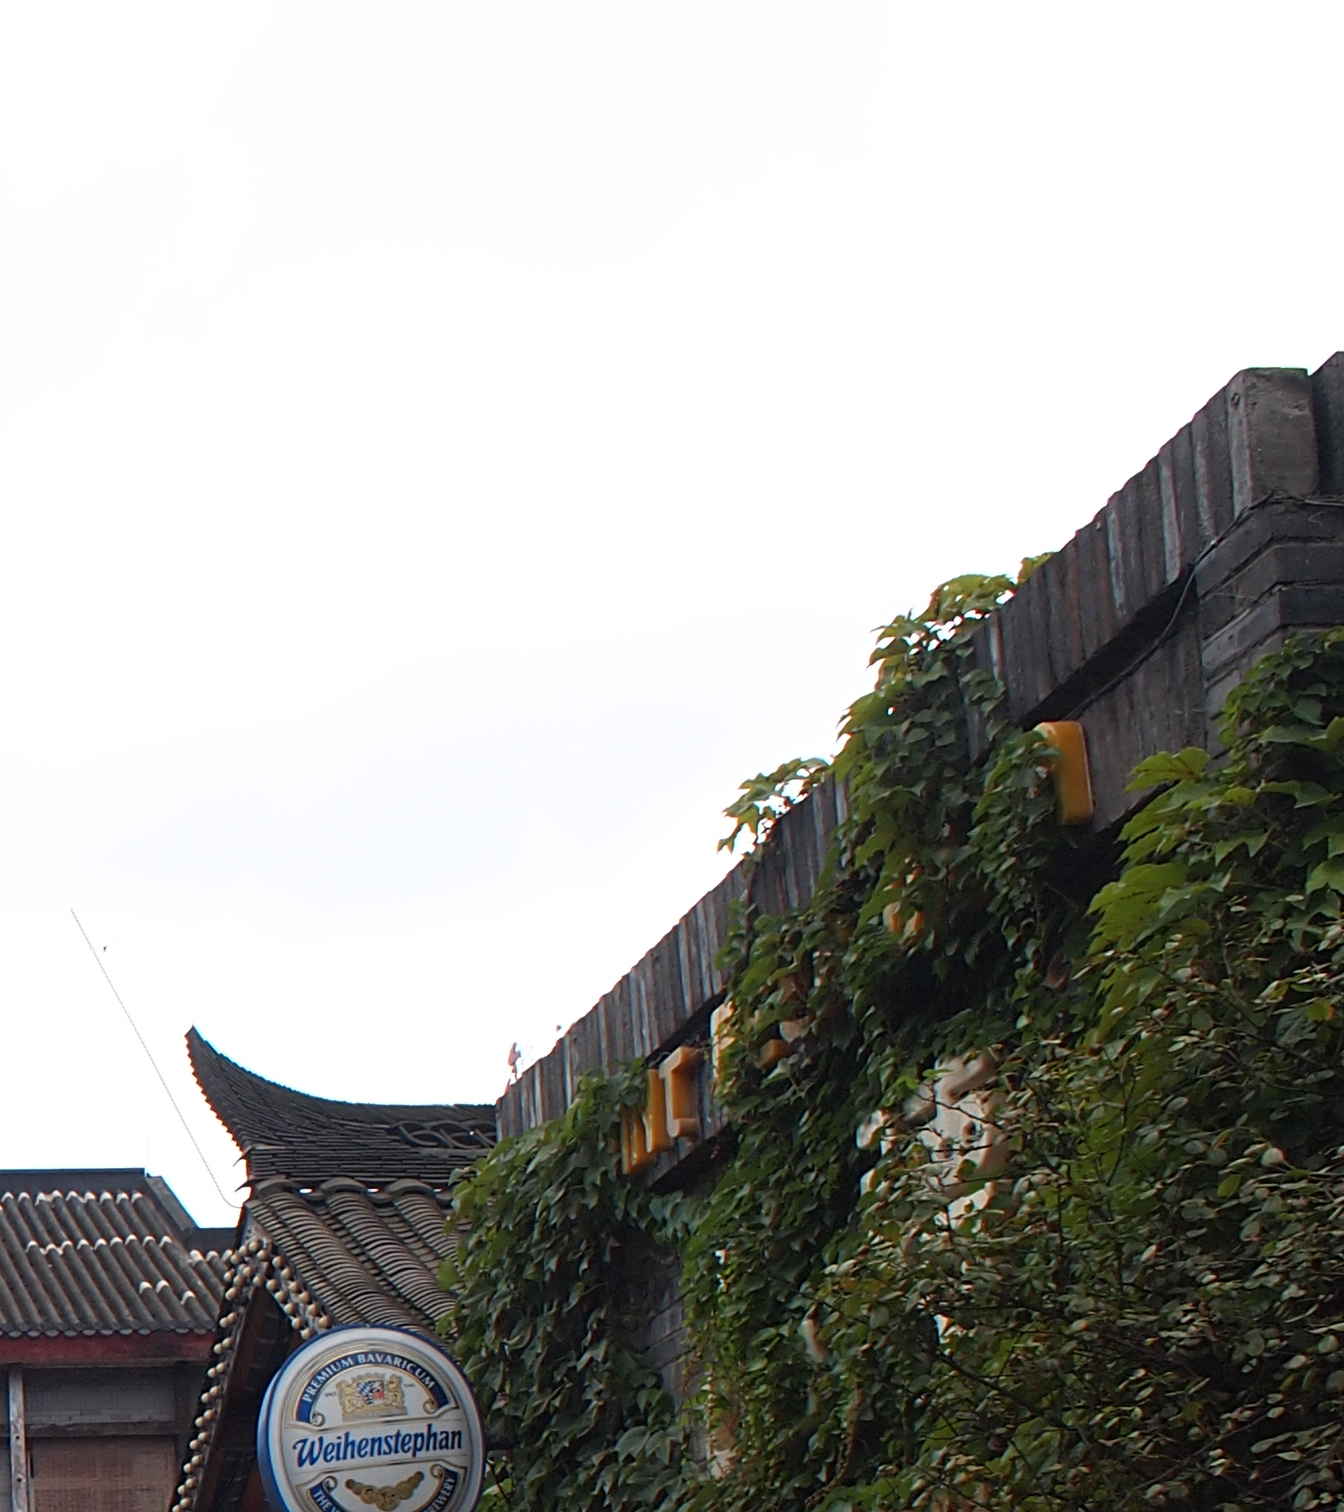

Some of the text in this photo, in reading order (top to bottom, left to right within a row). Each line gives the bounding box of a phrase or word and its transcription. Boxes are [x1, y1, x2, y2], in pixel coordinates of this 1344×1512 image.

[302, 1352, 436, 1403] PREMIUM BAVARICUM
[292, 1424, 462, 1467] Weihenstephan
[312, 1490, 330, 1512] THE
